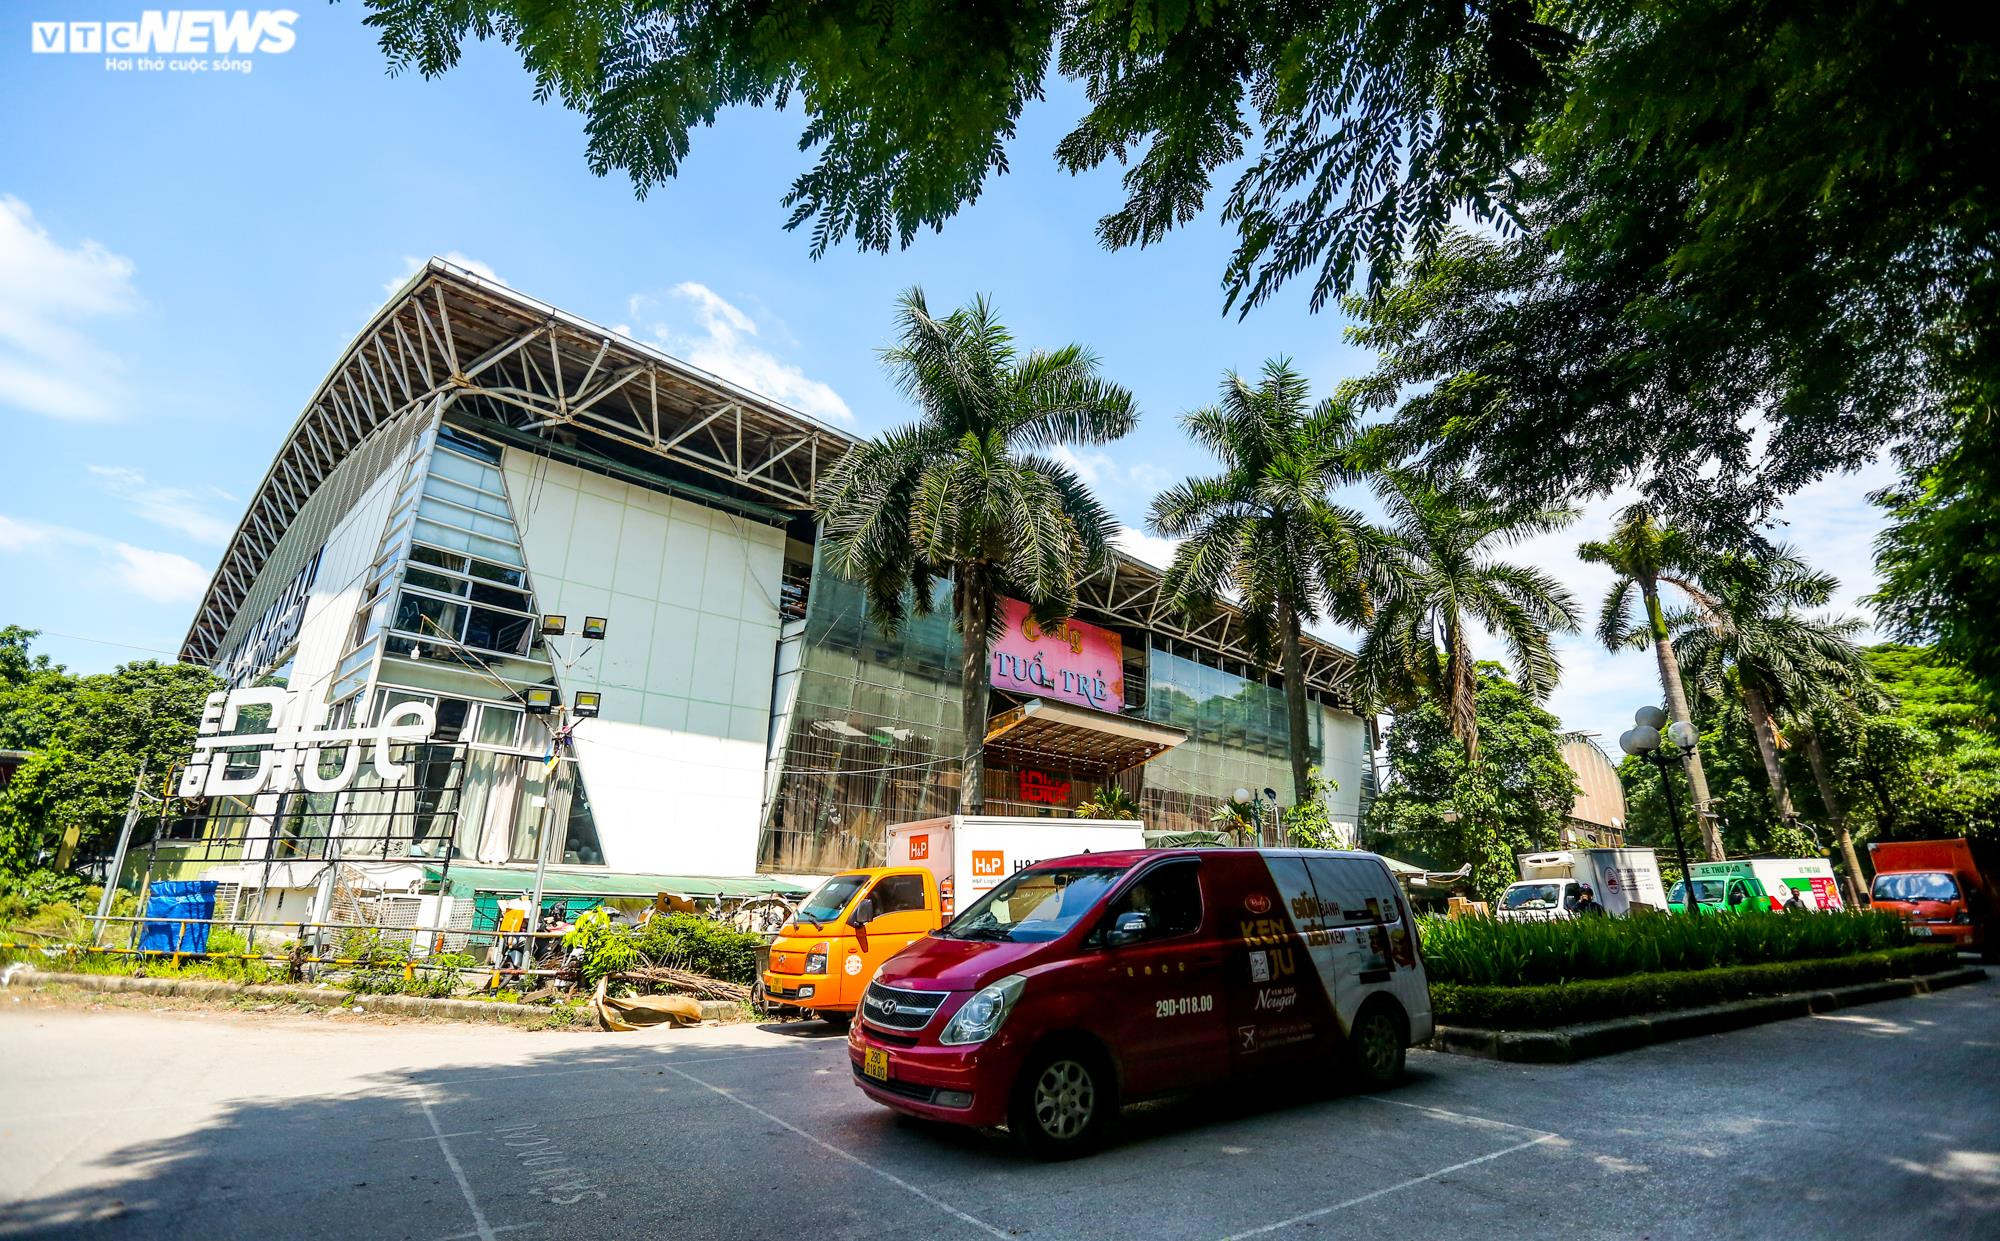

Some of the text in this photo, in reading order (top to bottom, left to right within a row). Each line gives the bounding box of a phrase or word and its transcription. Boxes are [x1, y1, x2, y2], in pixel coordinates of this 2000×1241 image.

[910, 842, 927, 857] H&P
[975, 857, 1001, 874] H&P
[1240, 918, 1289, 947] KEN
[1329, 930, 1347, 945] KEM
[1268, 948, 1296, 981] JU
[1155, 994, 1213, 1018] 29D-018.00
[1254, 987, 1297, 1013] Nougat
